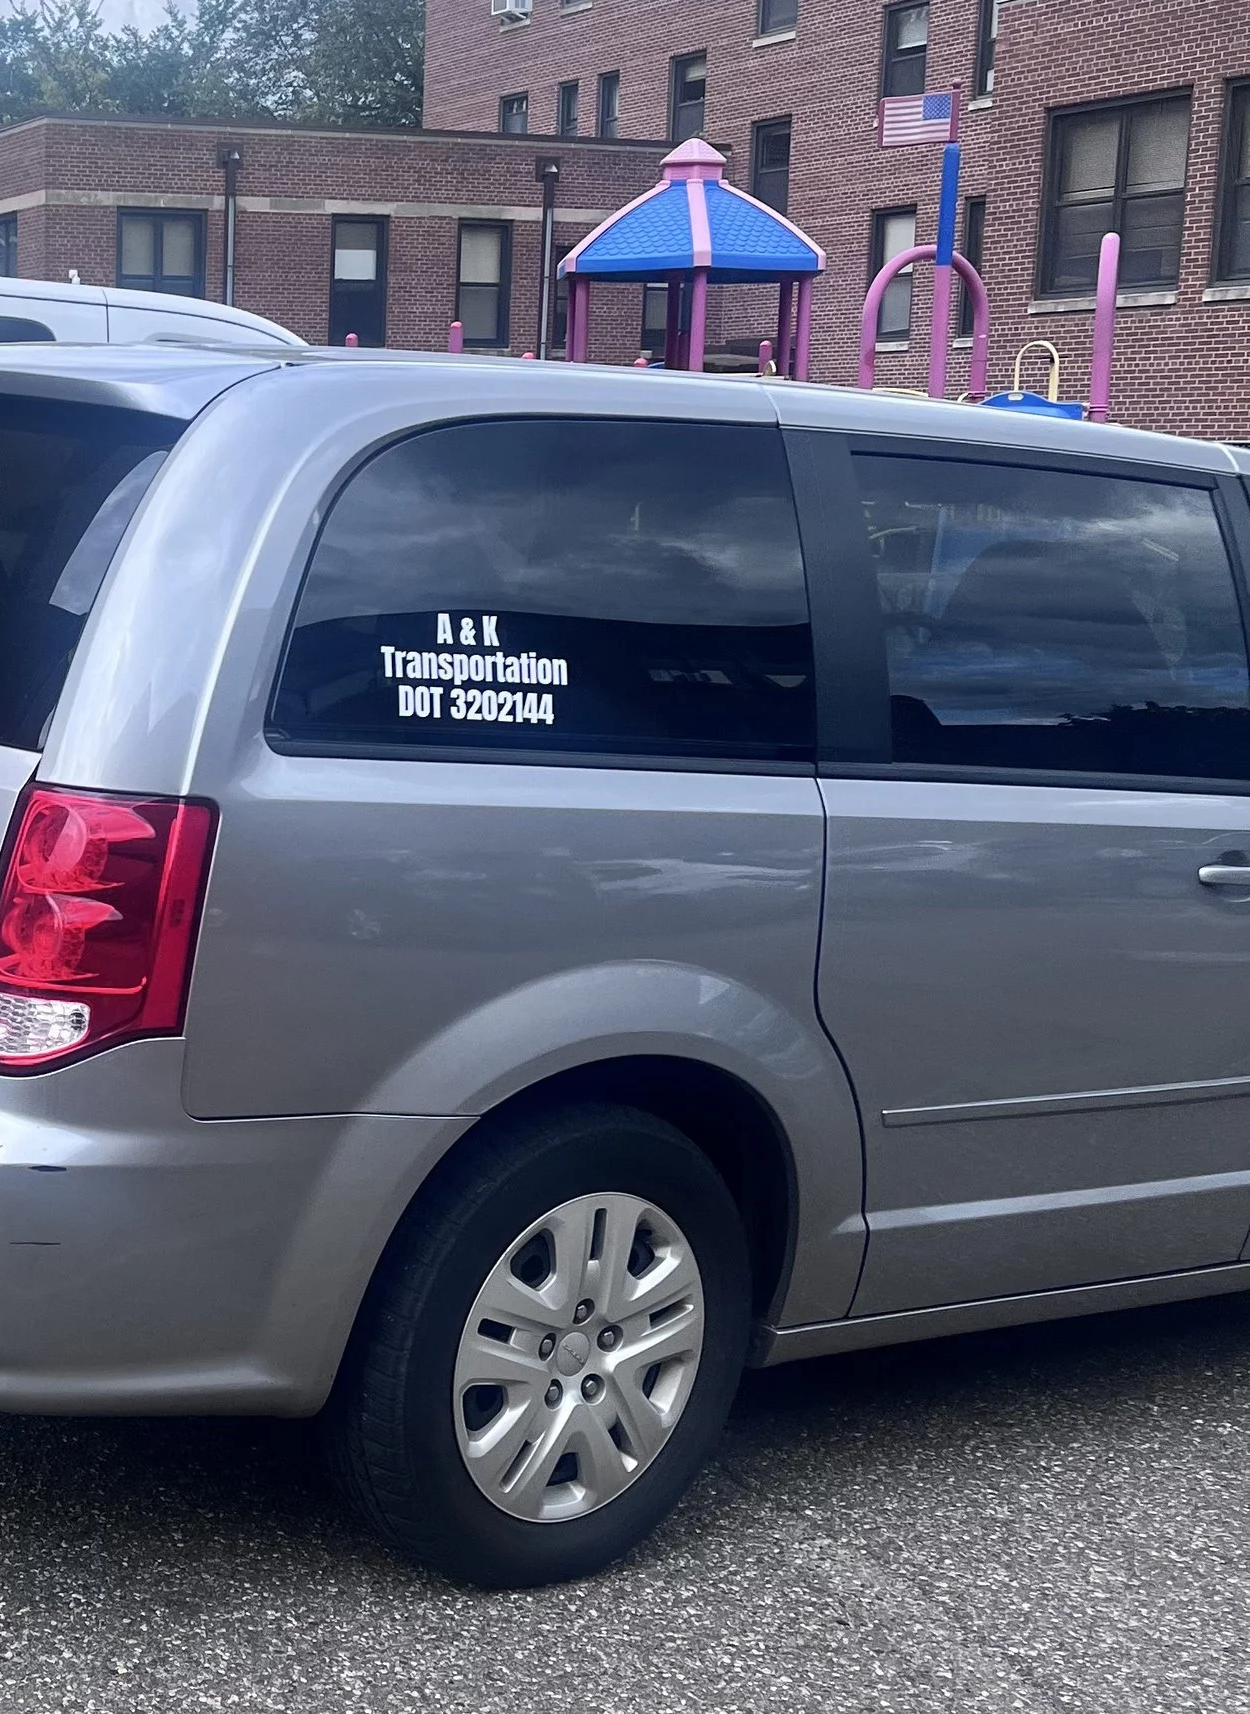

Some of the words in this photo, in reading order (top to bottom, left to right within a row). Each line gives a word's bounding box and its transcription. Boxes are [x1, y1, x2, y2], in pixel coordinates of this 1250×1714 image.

[436, 613, 454, 645] A
[459, 617, 477, 646] &
[482, 615, 500, 647] K
[380, 645, 568, 686] Transportation
[398, 685, 444, 719] DOT
[450, 688, 555, 725] 3202144
